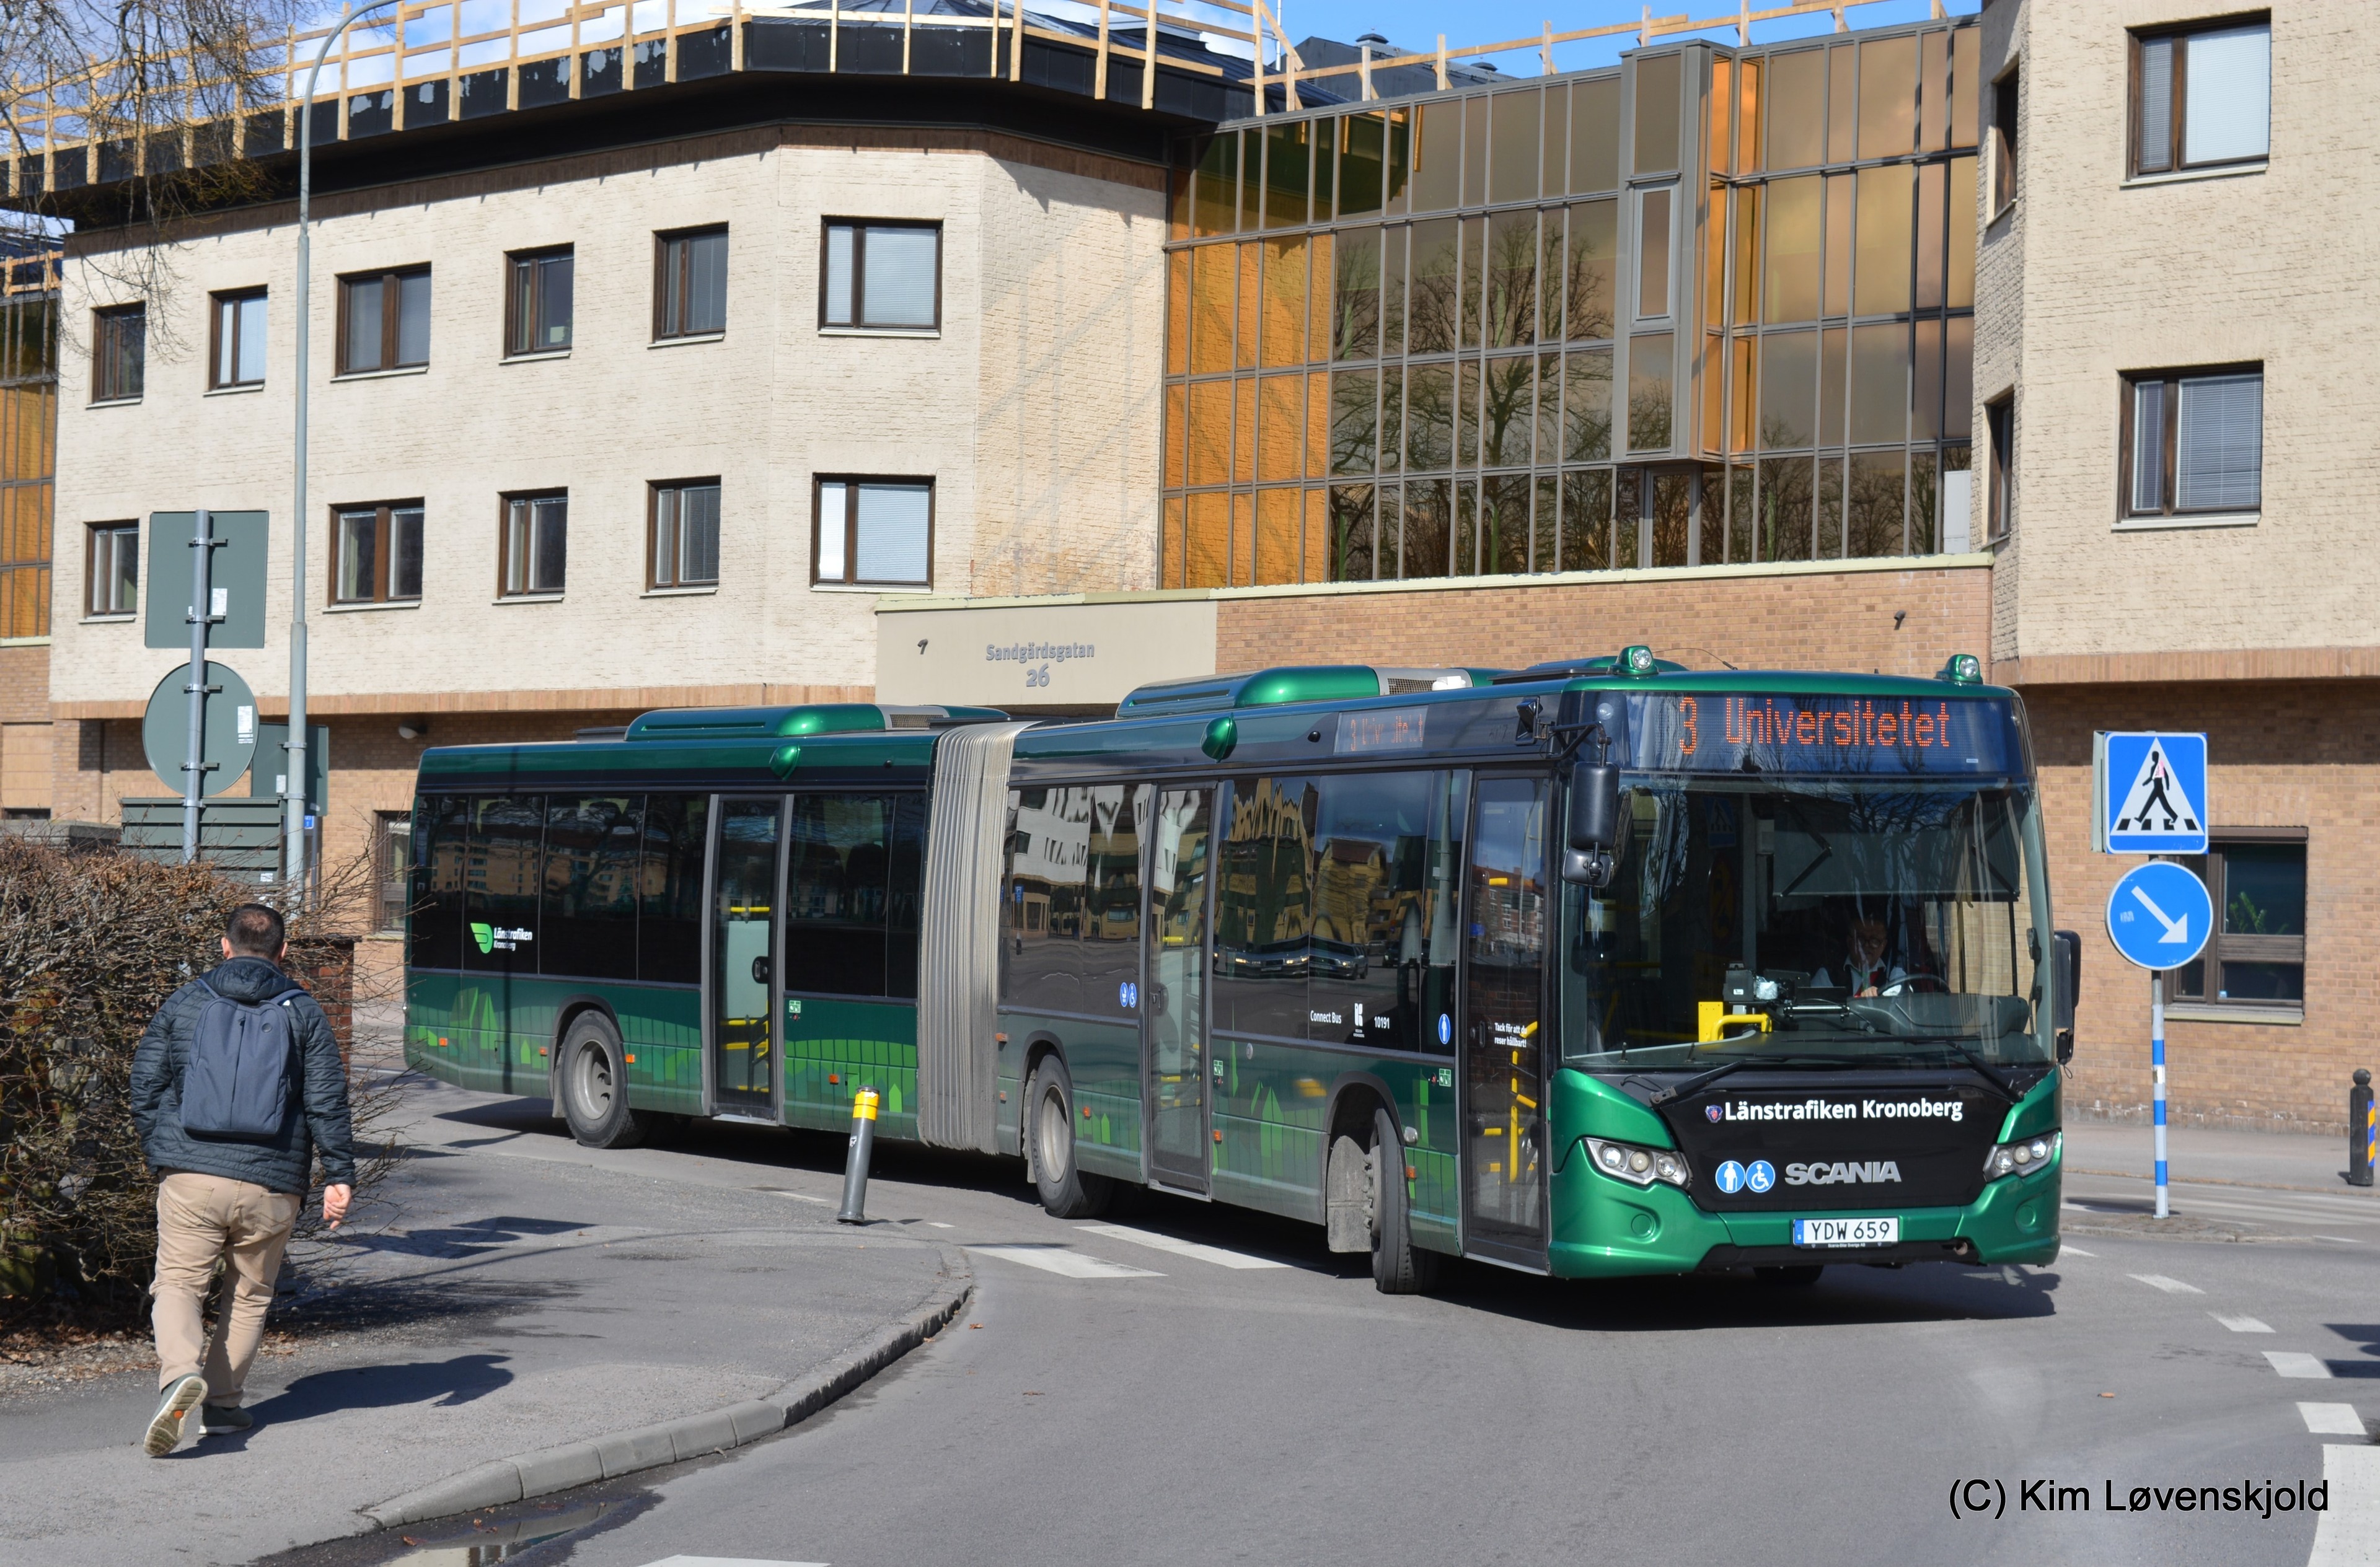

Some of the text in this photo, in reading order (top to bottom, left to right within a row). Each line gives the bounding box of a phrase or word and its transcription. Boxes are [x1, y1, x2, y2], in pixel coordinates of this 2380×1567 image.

[986, 642, 1095, 664] Sandgärdsgatan
[1026, 663, 1051, 687] 26
[1679, 696, 1950, 755] 3 Universitetet
[494, 928, 532, 940] Länstrafiken
[1310, 1010, 1341, 1024] Connect Bus
[1374, 1016, 1390, 1029] 10191
[1494, 1022, 1505, 1032] Tack
[1520, 1025, 1527, 1034] du
[1507, 1036, 1527, 1047] hållbart!
[1725, 1099, 1963, 1121] Länstrafiken Kronoberg
[1784, 1161, 1902, 1185] SCANIA
[1811, 1221, 1890, 1240] YDW 659
